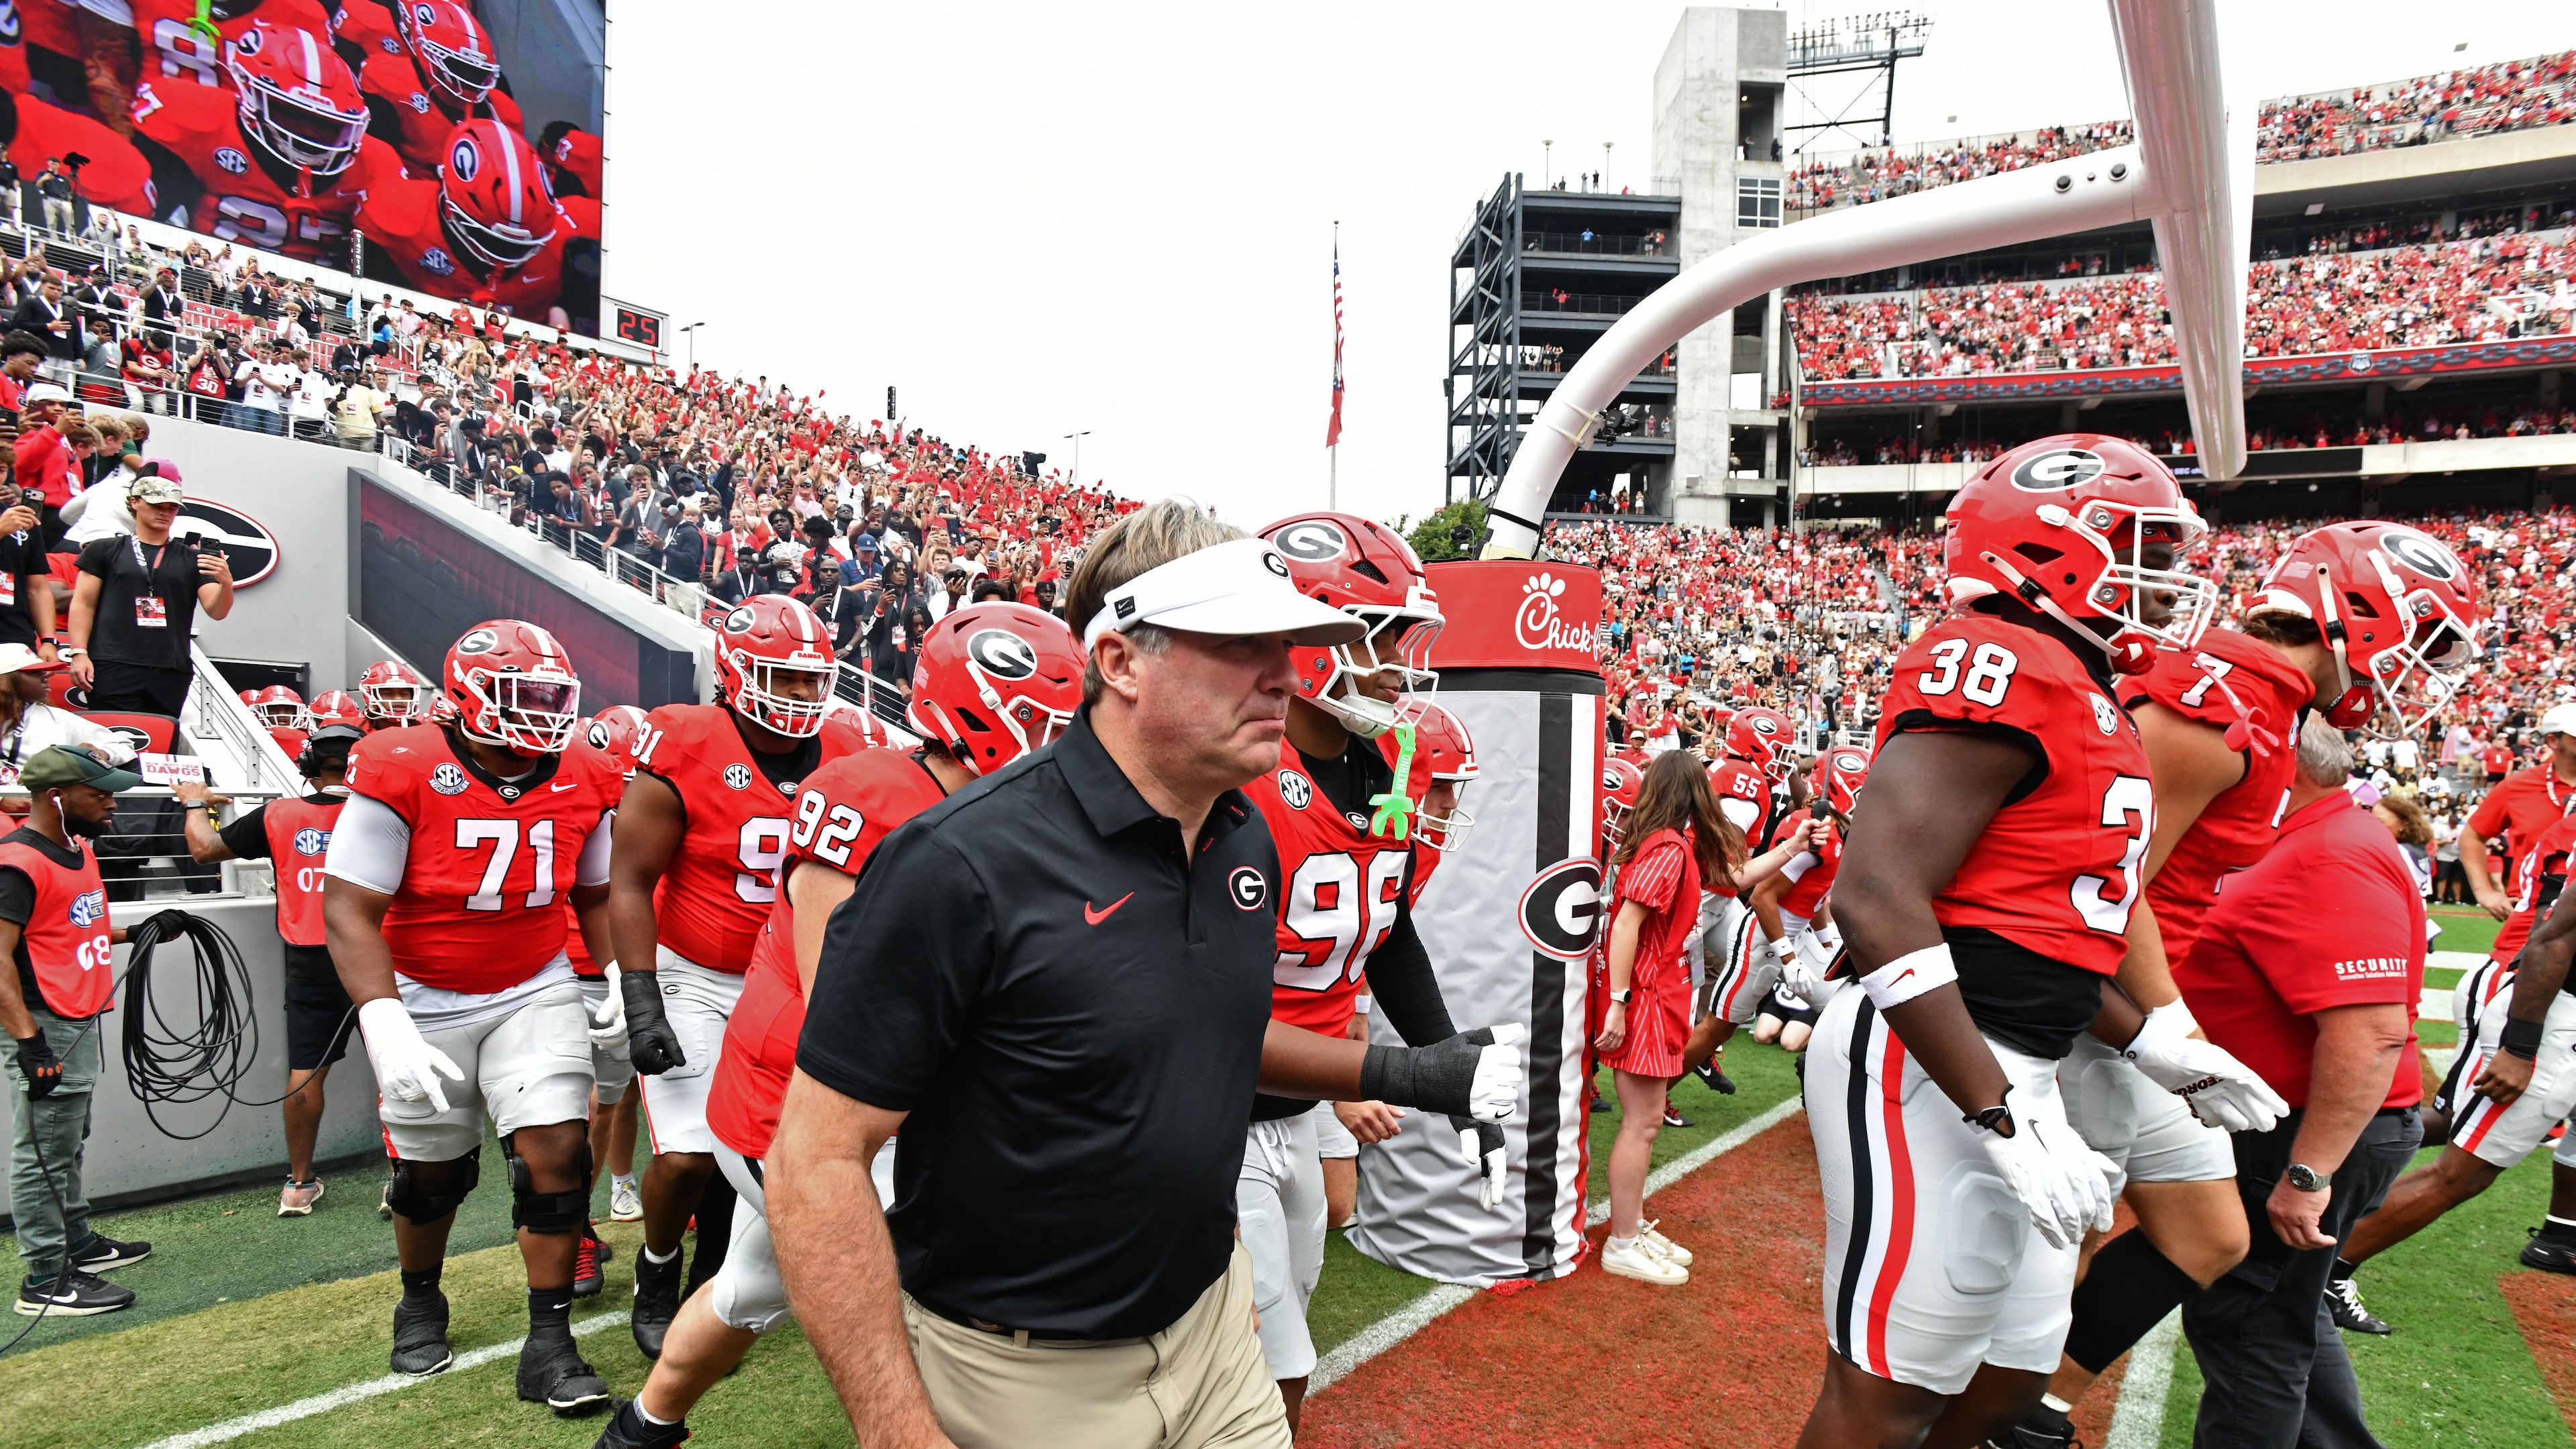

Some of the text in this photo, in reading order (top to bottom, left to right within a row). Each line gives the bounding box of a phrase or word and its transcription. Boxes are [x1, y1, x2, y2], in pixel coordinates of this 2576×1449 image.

[215, 150, 248, 174] SEC
[620, 311, 656, 345] 25
[195, 378, 219, 394] 30
[1515, 592, 1601, 661] Chick-f
[1918, 637, 2019, 708] 38
[2179, 651, 2235, 708] 7
[630, 720, 664, 765] 91
[146, 765, 201, 776] DAWGS
[437, 763, 463, 788] SEC
[724, 764, 751, 790] SEC
[1395, 753, 1411, 792] NXTRND
[1733, 772, 1762, 798] 55
[433, 782, 466, 795] GRADUATE
[1281, 773, 1311, 808] SEC
[297, 829, 321, 855] SEC
[792, 789, 865, 868] 92
[455, 818, 557, 912] 71
[735, 816, 791, 903] 9
[2070, 775, 2155, 936] 3
[297, 867, 325, 893] 07
[1274, 849, 1410, 992] 96
[2334, 958, 2408, 974] SECURITY
